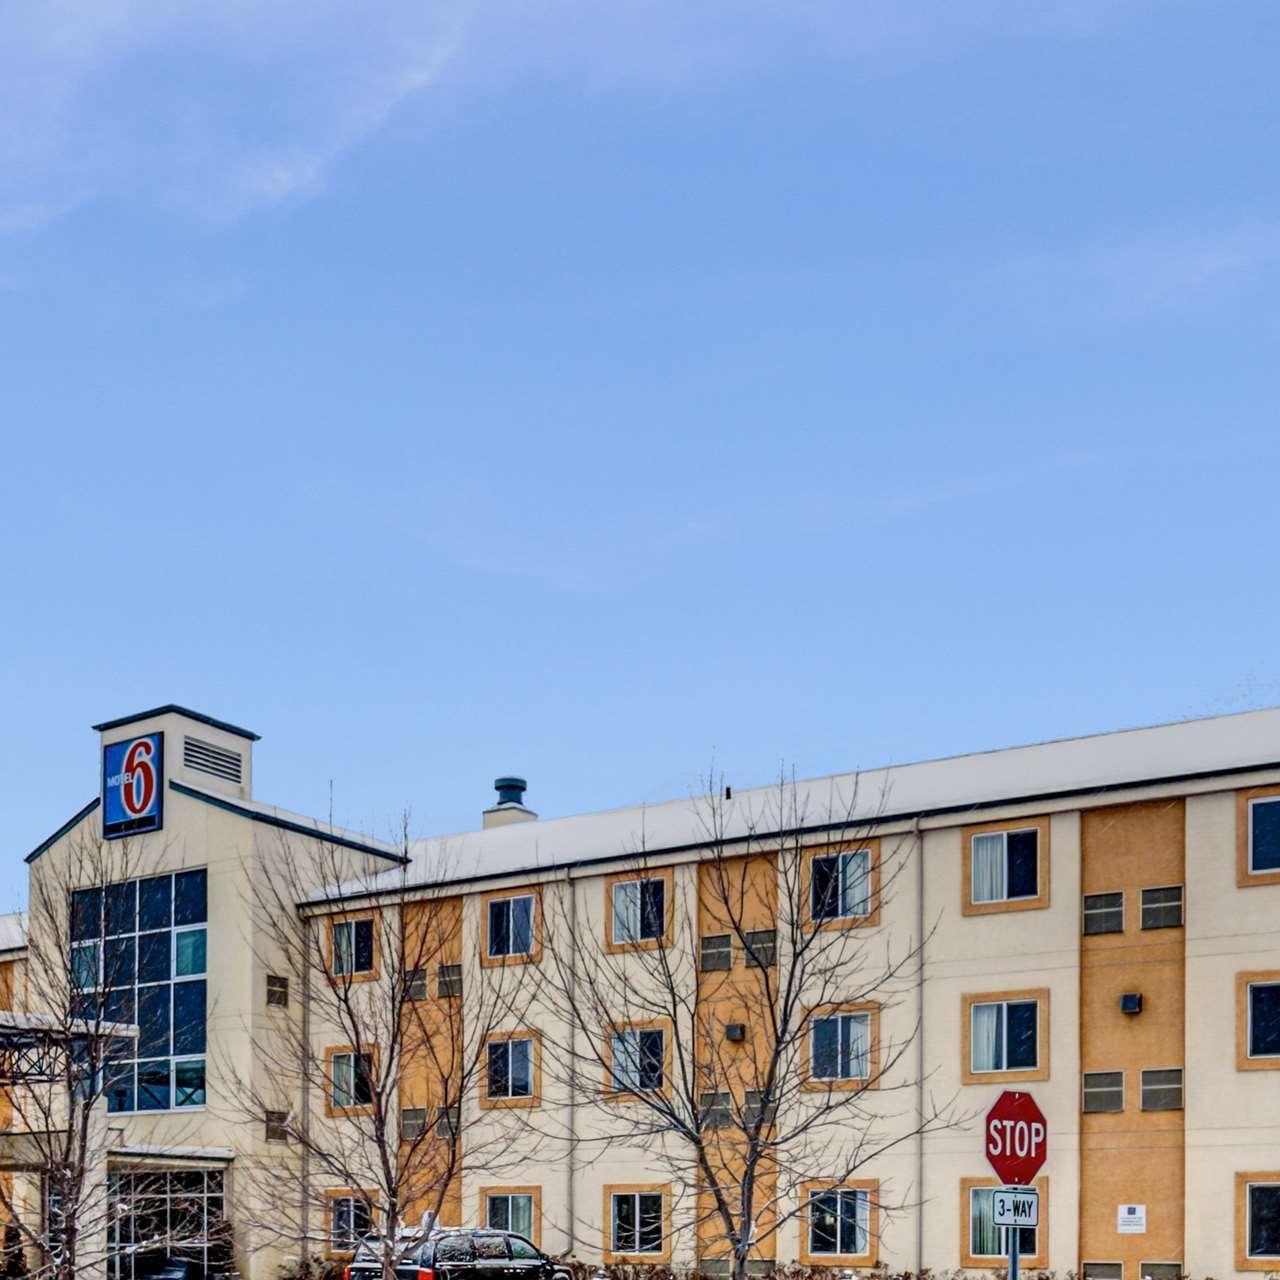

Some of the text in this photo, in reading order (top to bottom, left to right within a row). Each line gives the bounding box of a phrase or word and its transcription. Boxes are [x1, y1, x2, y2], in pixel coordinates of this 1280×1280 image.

[107, 739, 155, 816] MOTEL 6
[989, 1119, 1045, 1158] STOP
[998, 1199, 1034, 1218] 3-WAY
